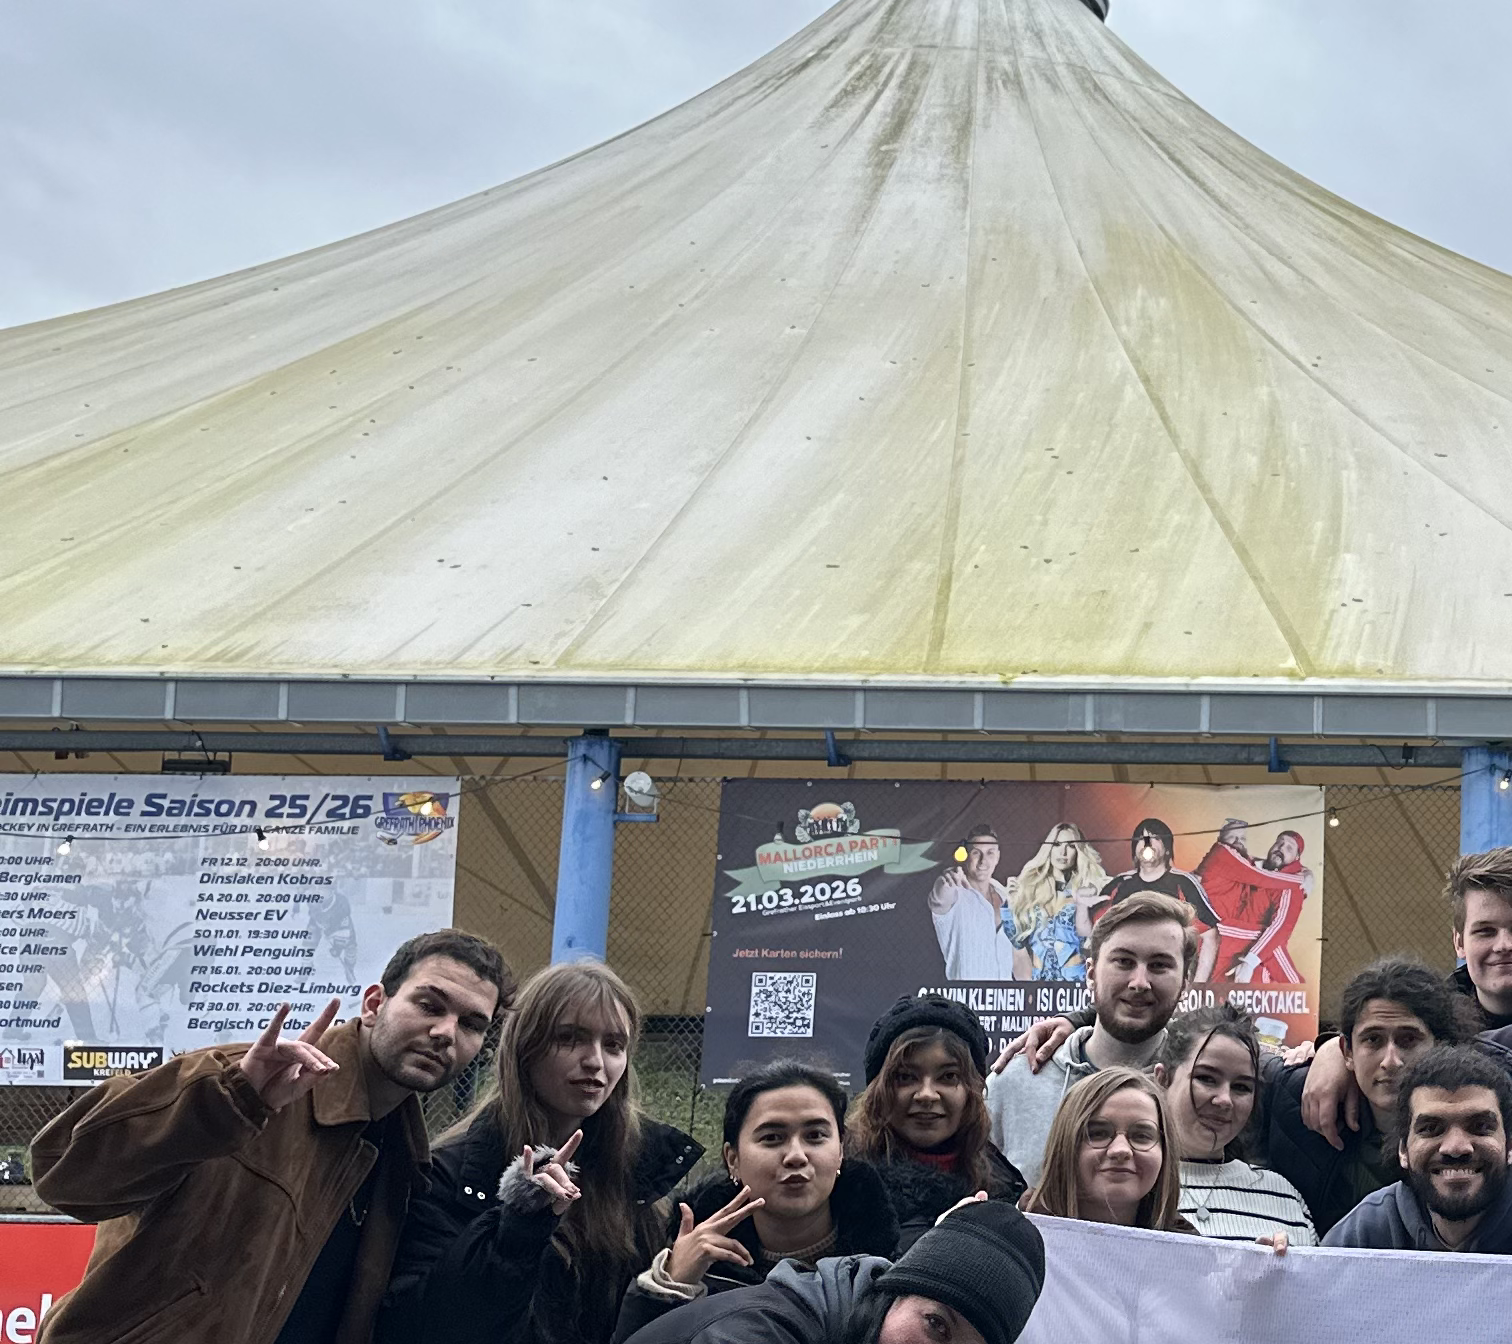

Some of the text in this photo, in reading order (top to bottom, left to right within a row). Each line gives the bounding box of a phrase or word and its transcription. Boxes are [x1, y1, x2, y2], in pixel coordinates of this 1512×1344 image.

[0, 792, 374, 824] imspiele Saison 25/26
[36, 824, 50, 833] IN
[52, 823, 114, 833] GREFRATH
[124, 824, 147, 833] EIN
[149, 824, 210, 834] ERLEBNIS
[212, 822, 237, 834] FÜR
[308, 826, 360, 836] FAMILIE
[758, 841, 847, 865] MALLORCA
[200, 858, 219, 867] FR
[255, 858, 290, 868] 20:00
[783, 850, 878, 874] NIEDERRHEIN
[0, 871, 82, 886] Bergkamen
[199, 873, 334, 886] Dinslaken Kobras
[196, 893, 214, 903] SA
[255, 894, 291, 903] 20:00
[293, 894, 325, 904] UHR:
[731, 877, 863, 914] 21.03.2026
[881, 902, 897, 911] Uhr
[27, 908, 77, 919] Moers
[195, 908, 289, 921] Neusser EV
[193, 929, 211, 939] SO
[247, 930, 279, 940] 19:30
[281, 930, 313, 940] UHR:
[20, 943, 68, 956] Aliens
[193, 944, 316, 960] Wiehl Penguins
[732, 947, 844, 960] Jetzt Karten sichern!
[190, 965, 209, 975] FR
[246, 966, 282, 976] 20:00
[284, 966, 317, 976] UHR:
[189, 981, 362, 997] Rockets Diez-Limburg
[187, 1002, 205, 1011] FR
[290, 1002, 316, 1012] HR:
[968, 987, 1025, 1012] KLEINEN
[1036, 988, 1054, 1012] ISI
[1228, 989, 1311, 1014] SPECKTAKEL
[187, 1017, 255, 1033] Bergisch
[67, 1050, 159, 1070] SUBWAY
[93, 1068, 132, 1077] KREFELD
